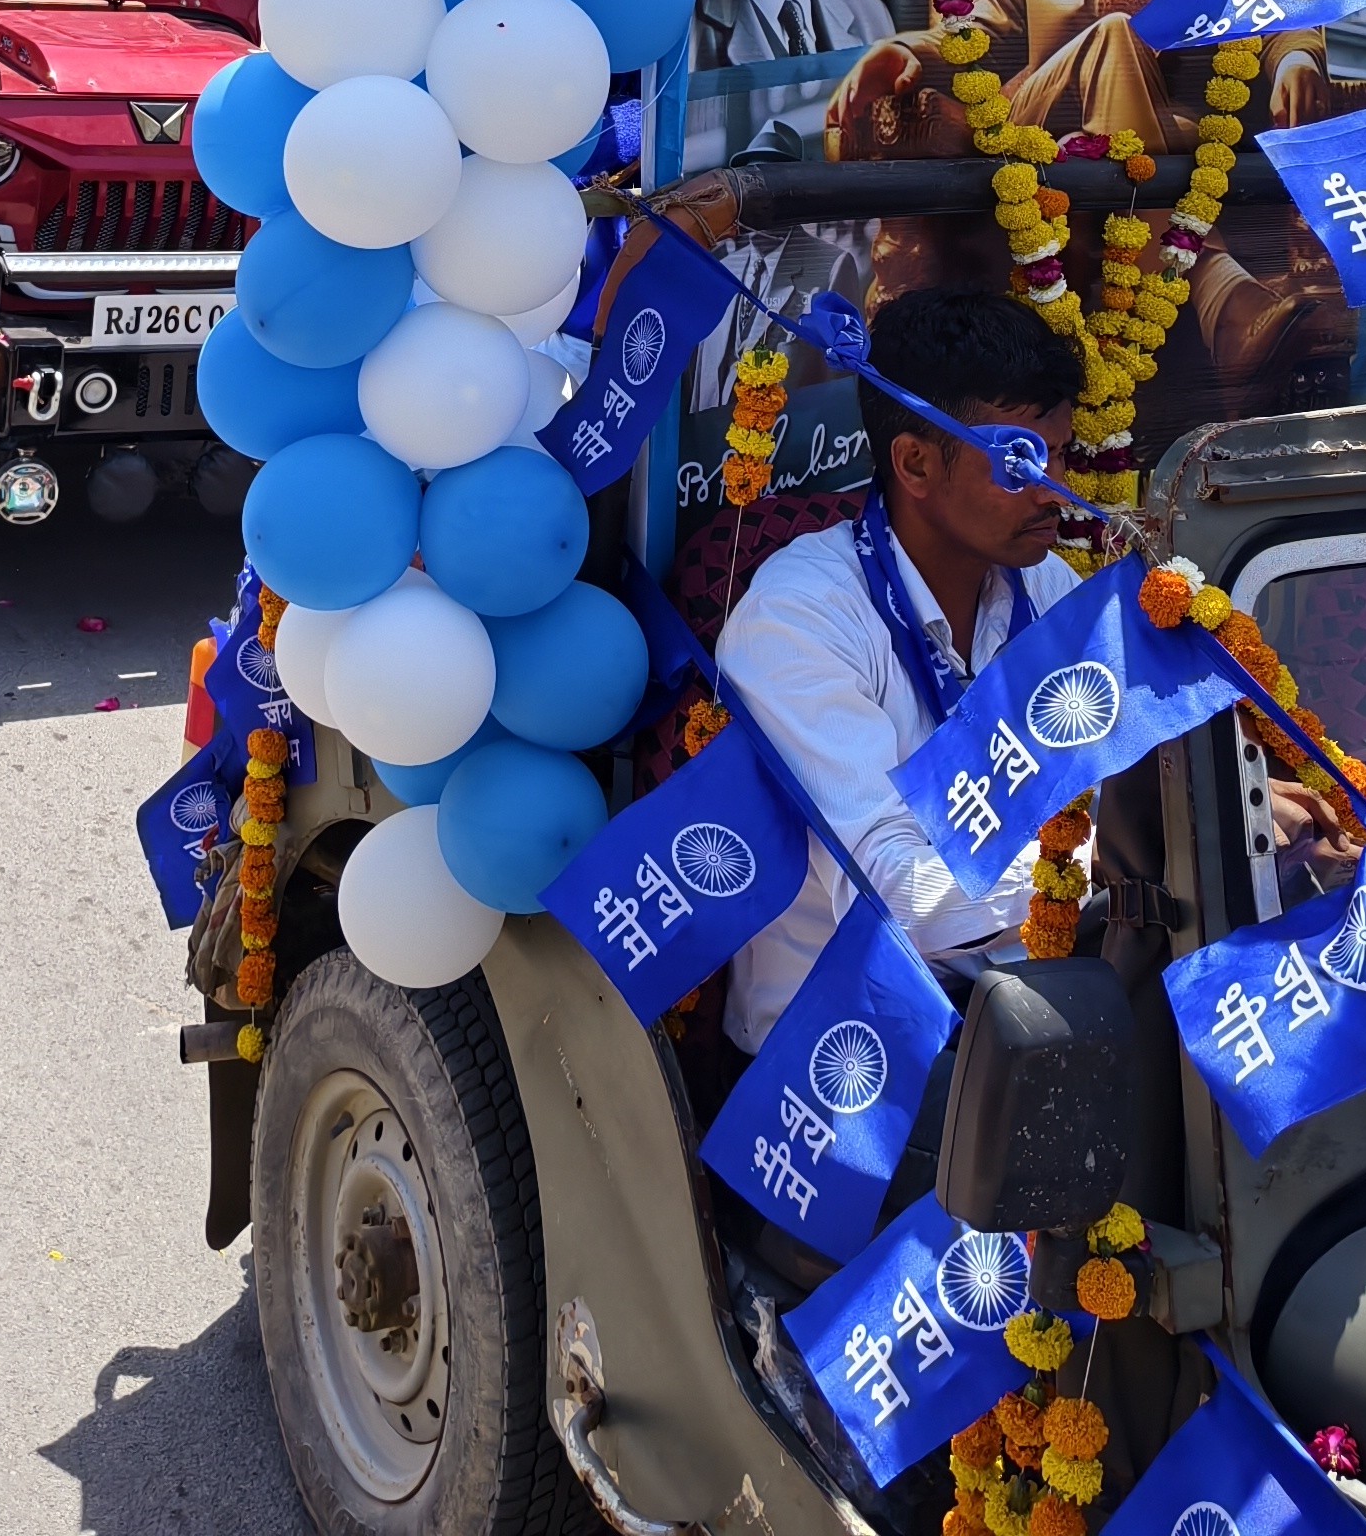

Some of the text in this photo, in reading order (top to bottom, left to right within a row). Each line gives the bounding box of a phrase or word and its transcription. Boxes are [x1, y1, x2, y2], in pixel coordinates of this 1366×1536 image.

[571, 418, 614, 469] भीम
[601, 377, 636, 433] जय
[987, 719, 1041, 799] जय
[947, 768, 1002, 856] भीम
[592, 885, 659, 973] भीम
[634, 852, 695, 931] जय
[1273, 941, 1332, 1035] जय
[1211, 980, 1277, 1086] भीम
[780, 1083, 837, 1165] जय
[753, 1134, 821, 1223] भीम
[892, 1277, 955, 1374] जय
[843, 1322, 912, 1429] भीम
